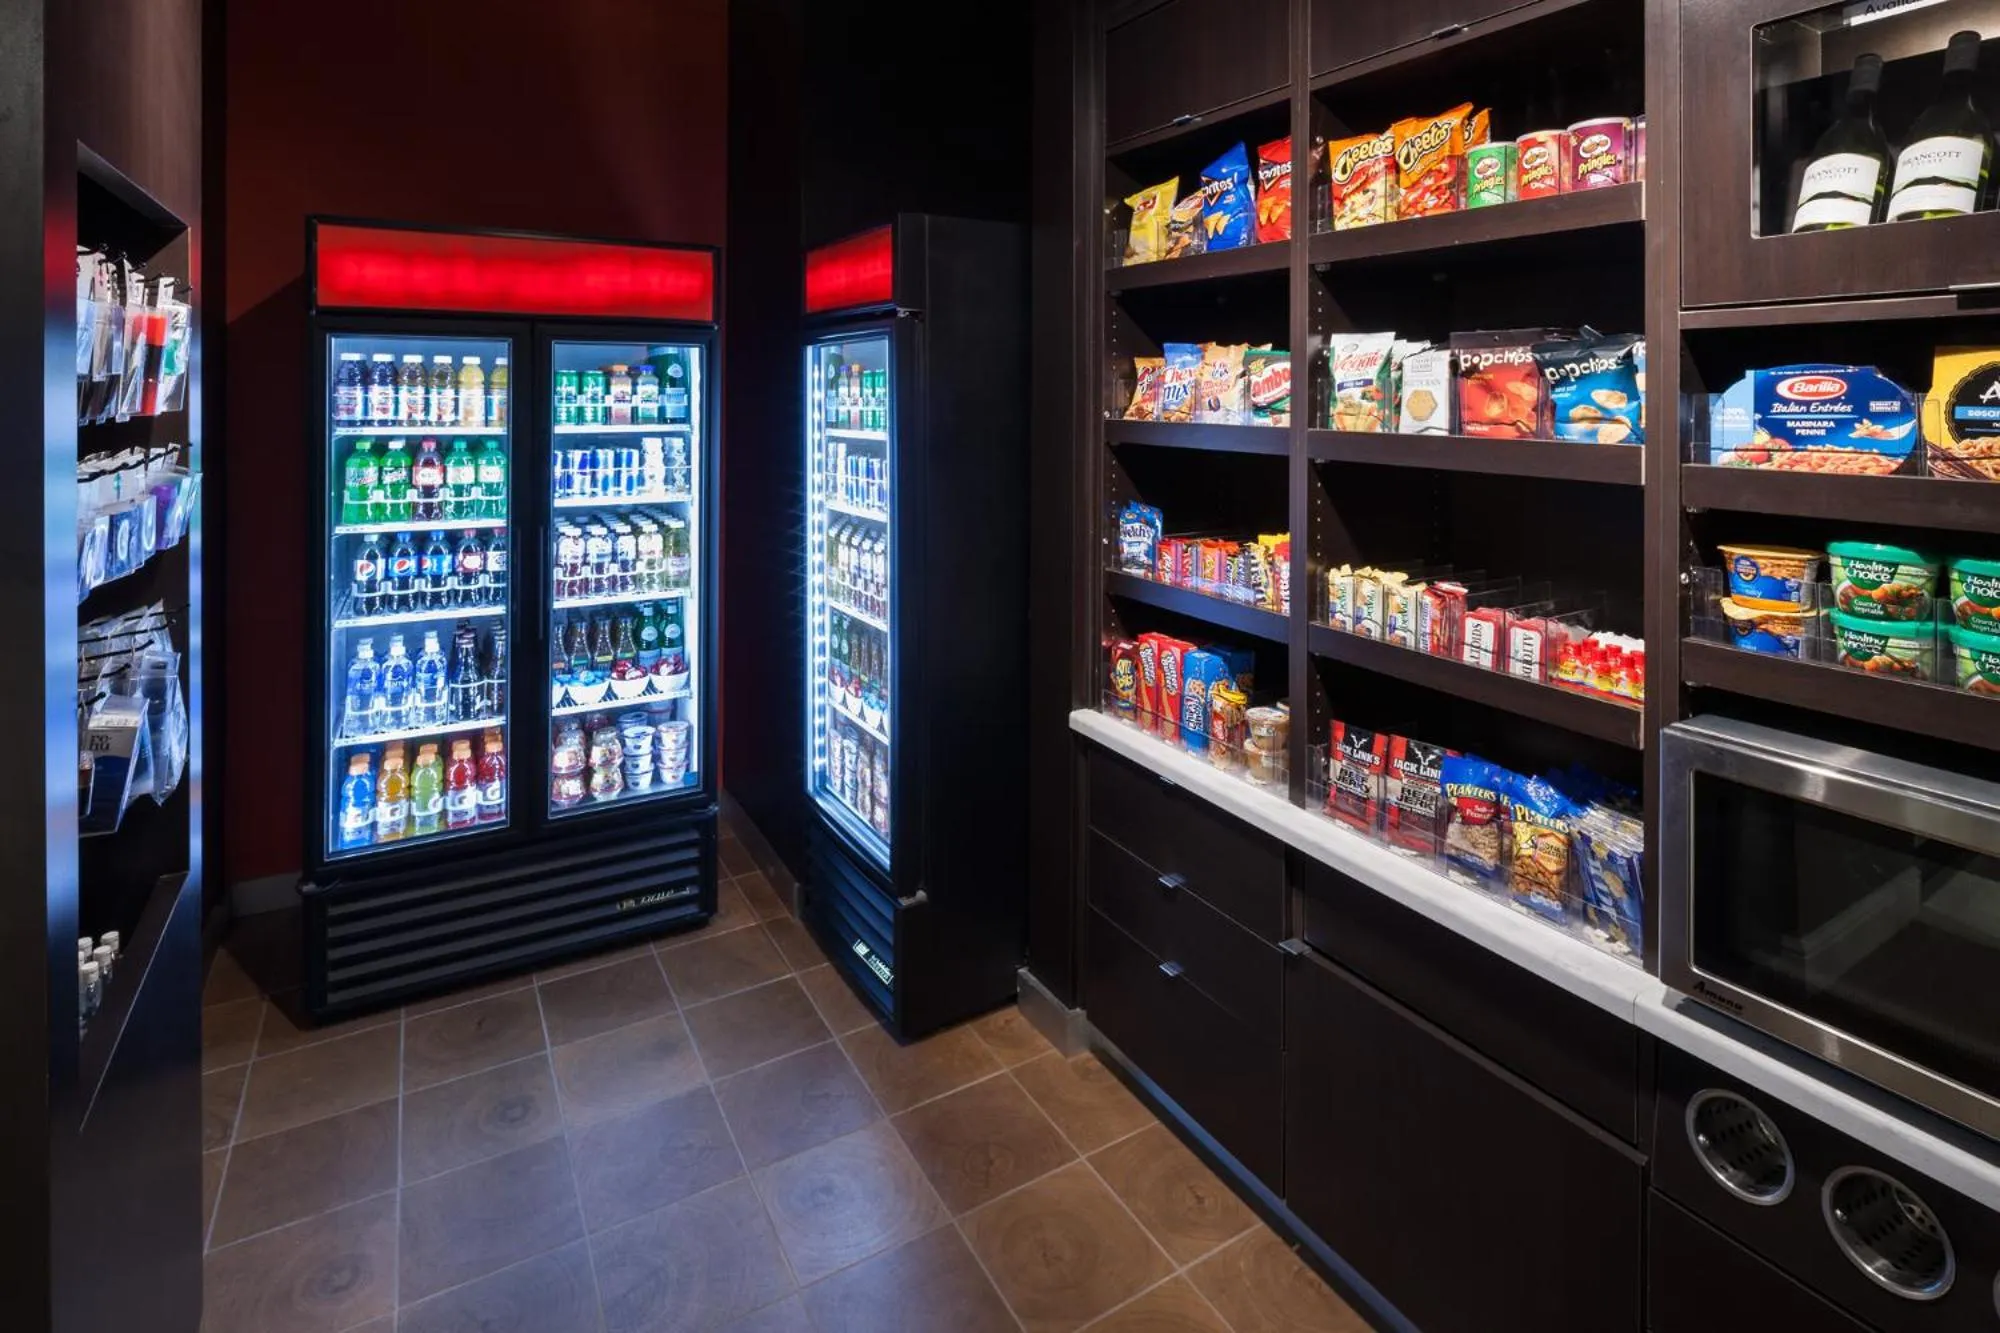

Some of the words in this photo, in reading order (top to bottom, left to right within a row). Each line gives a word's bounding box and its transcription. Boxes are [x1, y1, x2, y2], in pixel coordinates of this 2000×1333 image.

[1396, 118, 1453, 170] Cheetos
[1331, 136, 1394, 184] Cheetos
[1579, 152, 1616, 183] Pringles
[1460, 349, 1534, 371] popchips
[1545, 356, 1617, 382] popchips
[1793, 381, 1842, 394] Barilla
[1771, 402, 1807, 413] Italian
[1809, 401, 1853, 413] Entrées
[1787, 420, 1836, 429] MARINARA
[1795, 428, 1827, 436] PENNE
[1849, 559, 1895, 573] Healthy
[1845, 567, 1892, 583] Choice
[1844, 630, 1885, 645] Healthy
[1394, 757, 1418, 773] JACK
[1446, 783, 1497, 801] PLANTERS
